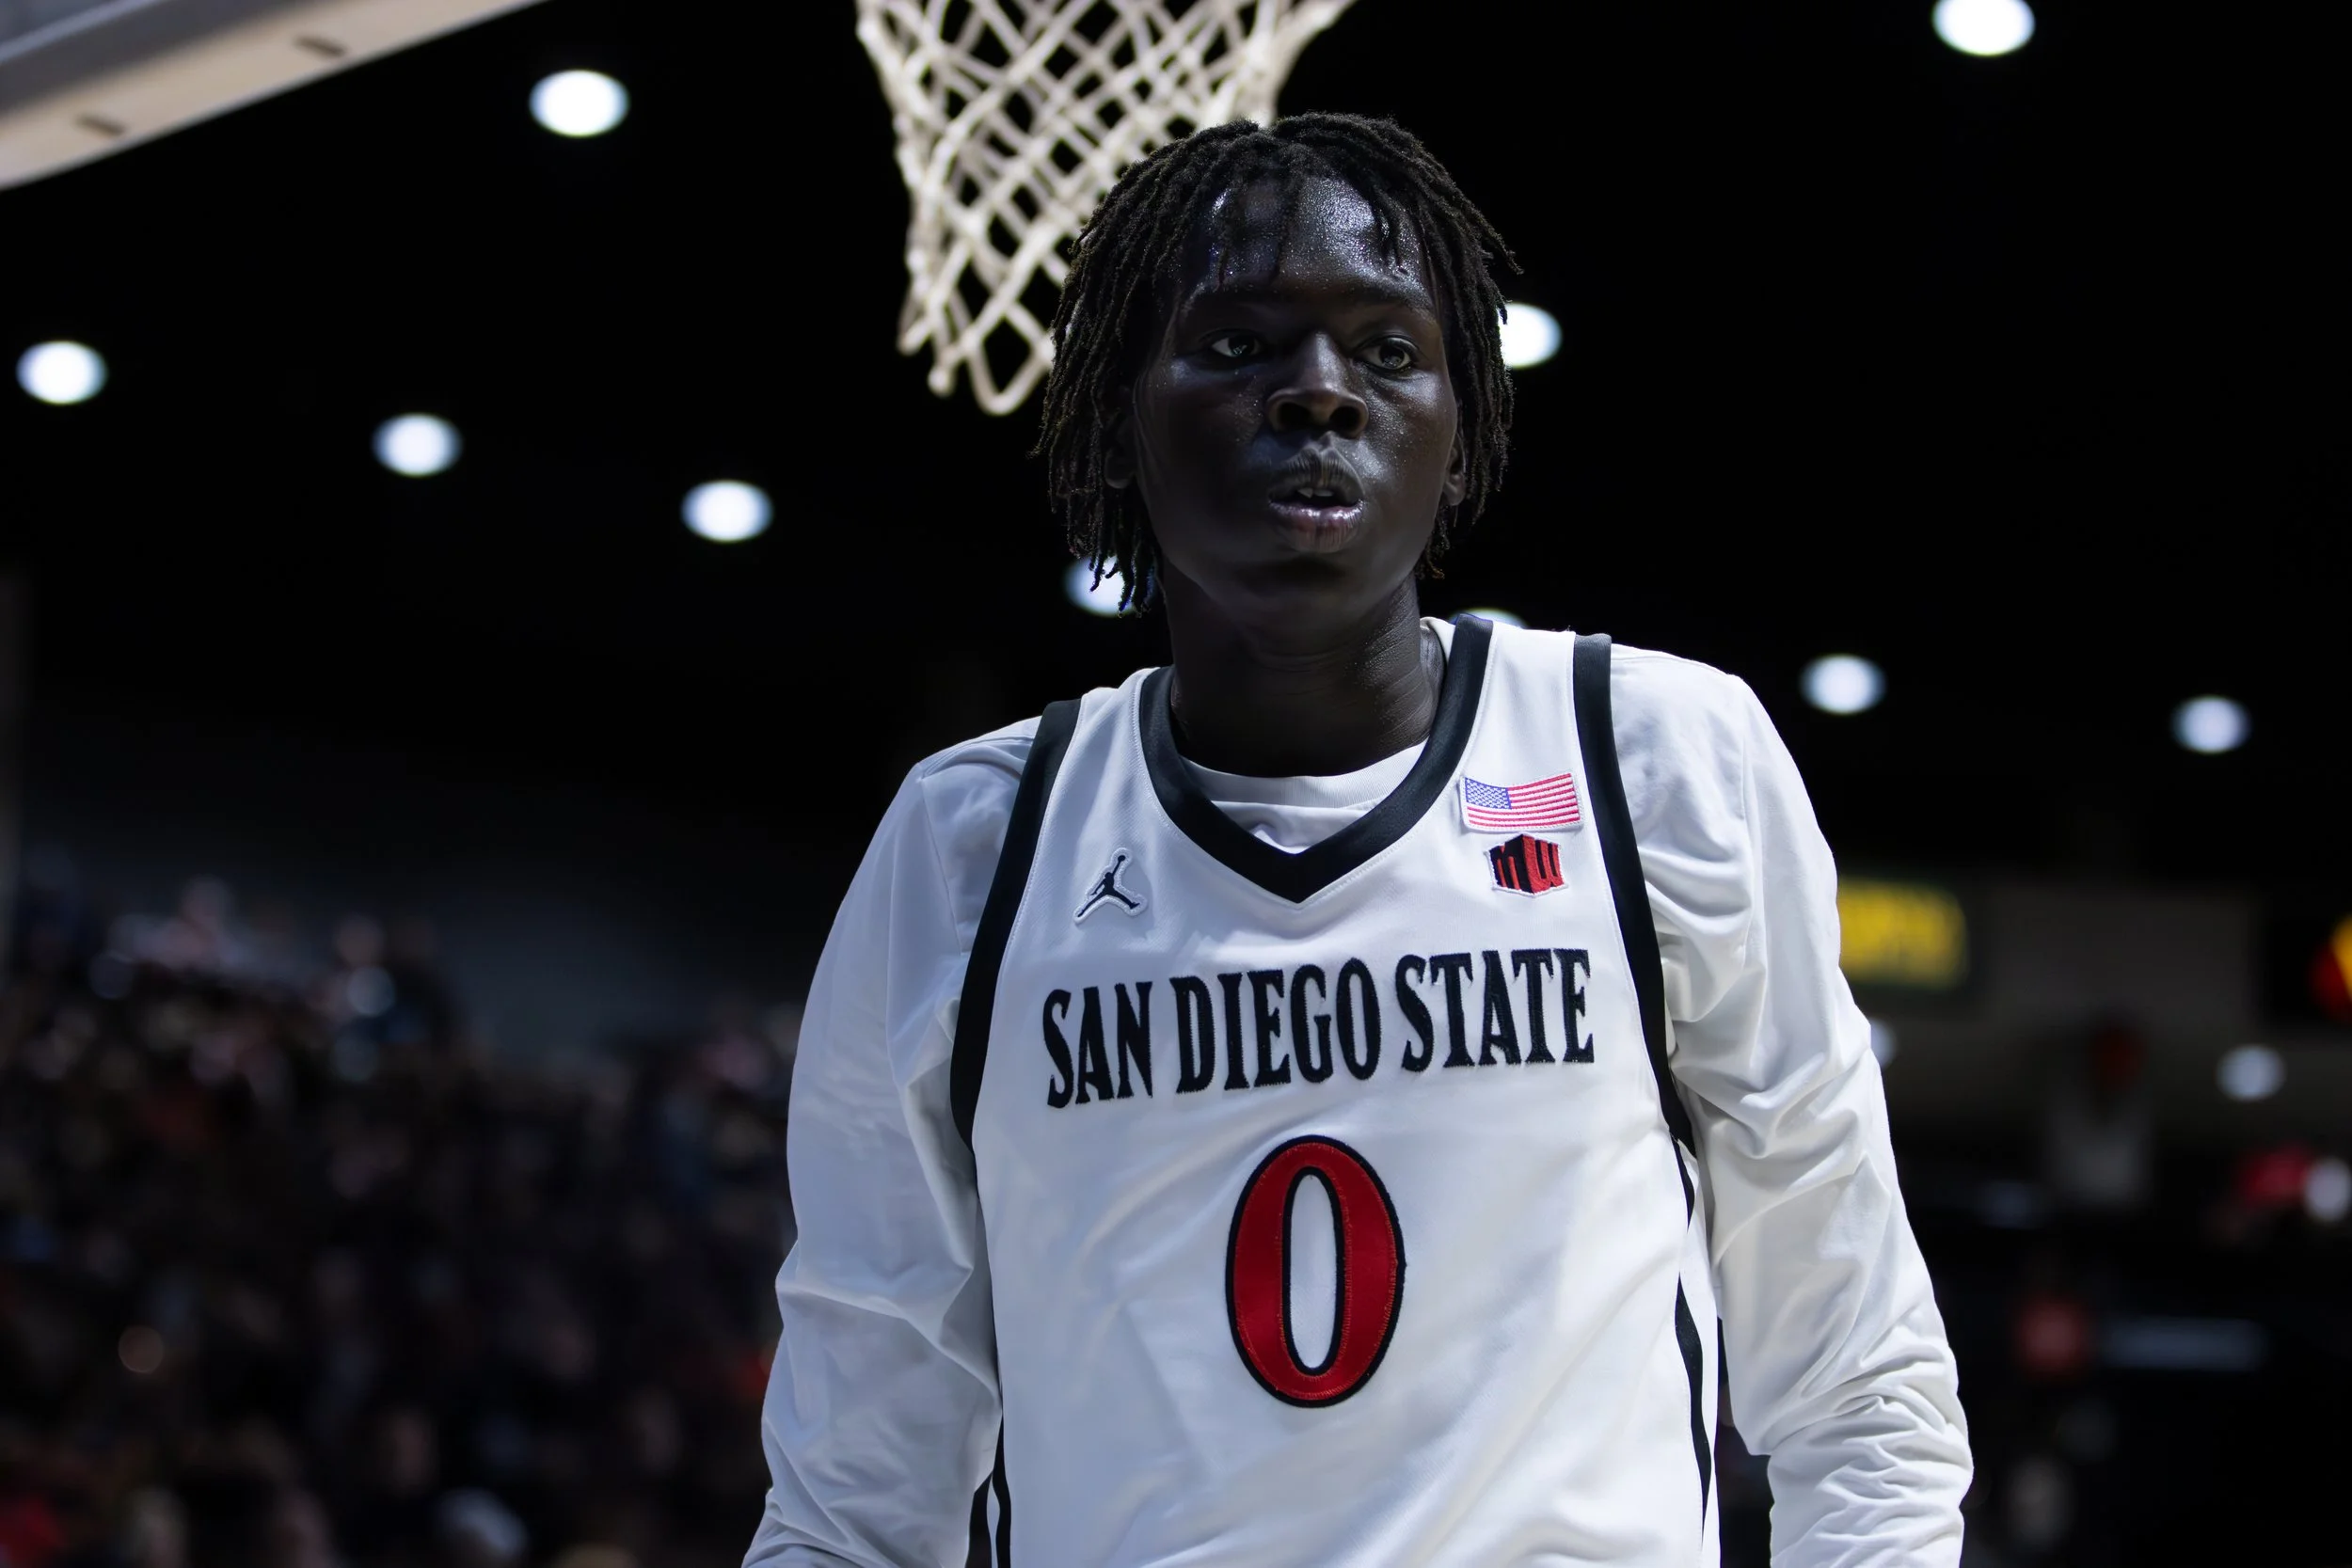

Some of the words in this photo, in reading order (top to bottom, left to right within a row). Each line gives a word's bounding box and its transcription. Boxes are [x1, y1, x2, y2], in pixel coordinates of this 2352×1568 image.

[1042, 980, 1153, 1109] SAN
[1169, 958, 1382, 1094] DIEGO
[1395, 948, 1595, 1072] STATE
[1225, 1134, 1406, 1408] 0
